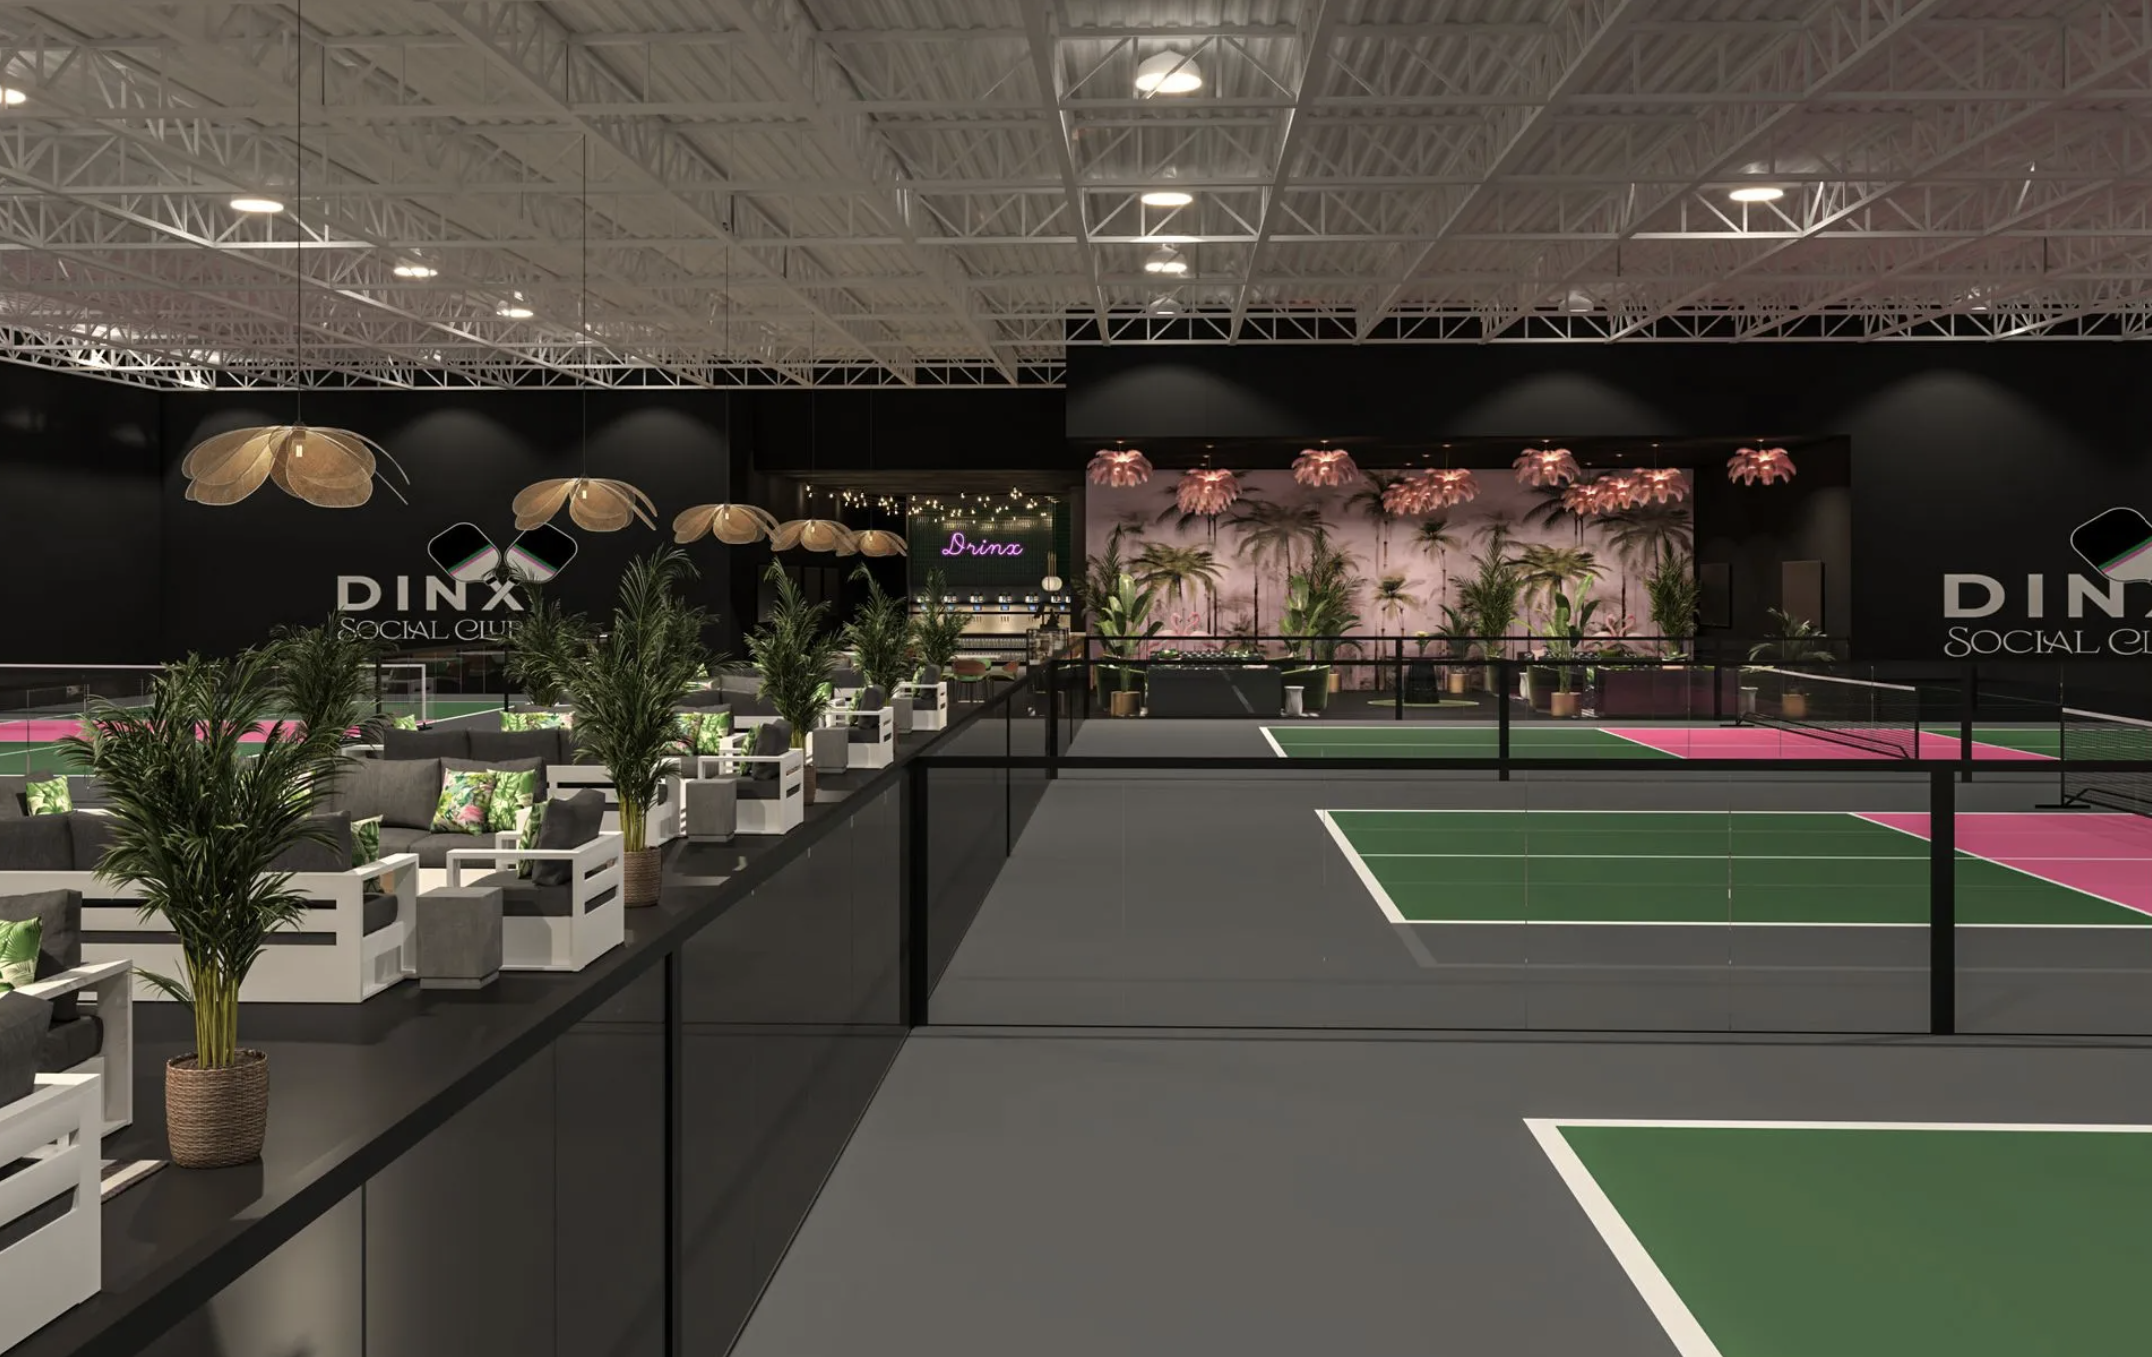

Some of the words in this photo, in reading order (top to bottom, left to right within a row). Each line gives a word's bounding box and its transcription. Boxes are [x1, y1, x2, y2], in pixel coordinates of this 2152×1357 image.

[941, 532, 1023, 556] Drinx
[337, 575, 524, 611] DINX
[1943, 573, 2152, 618] DIN
